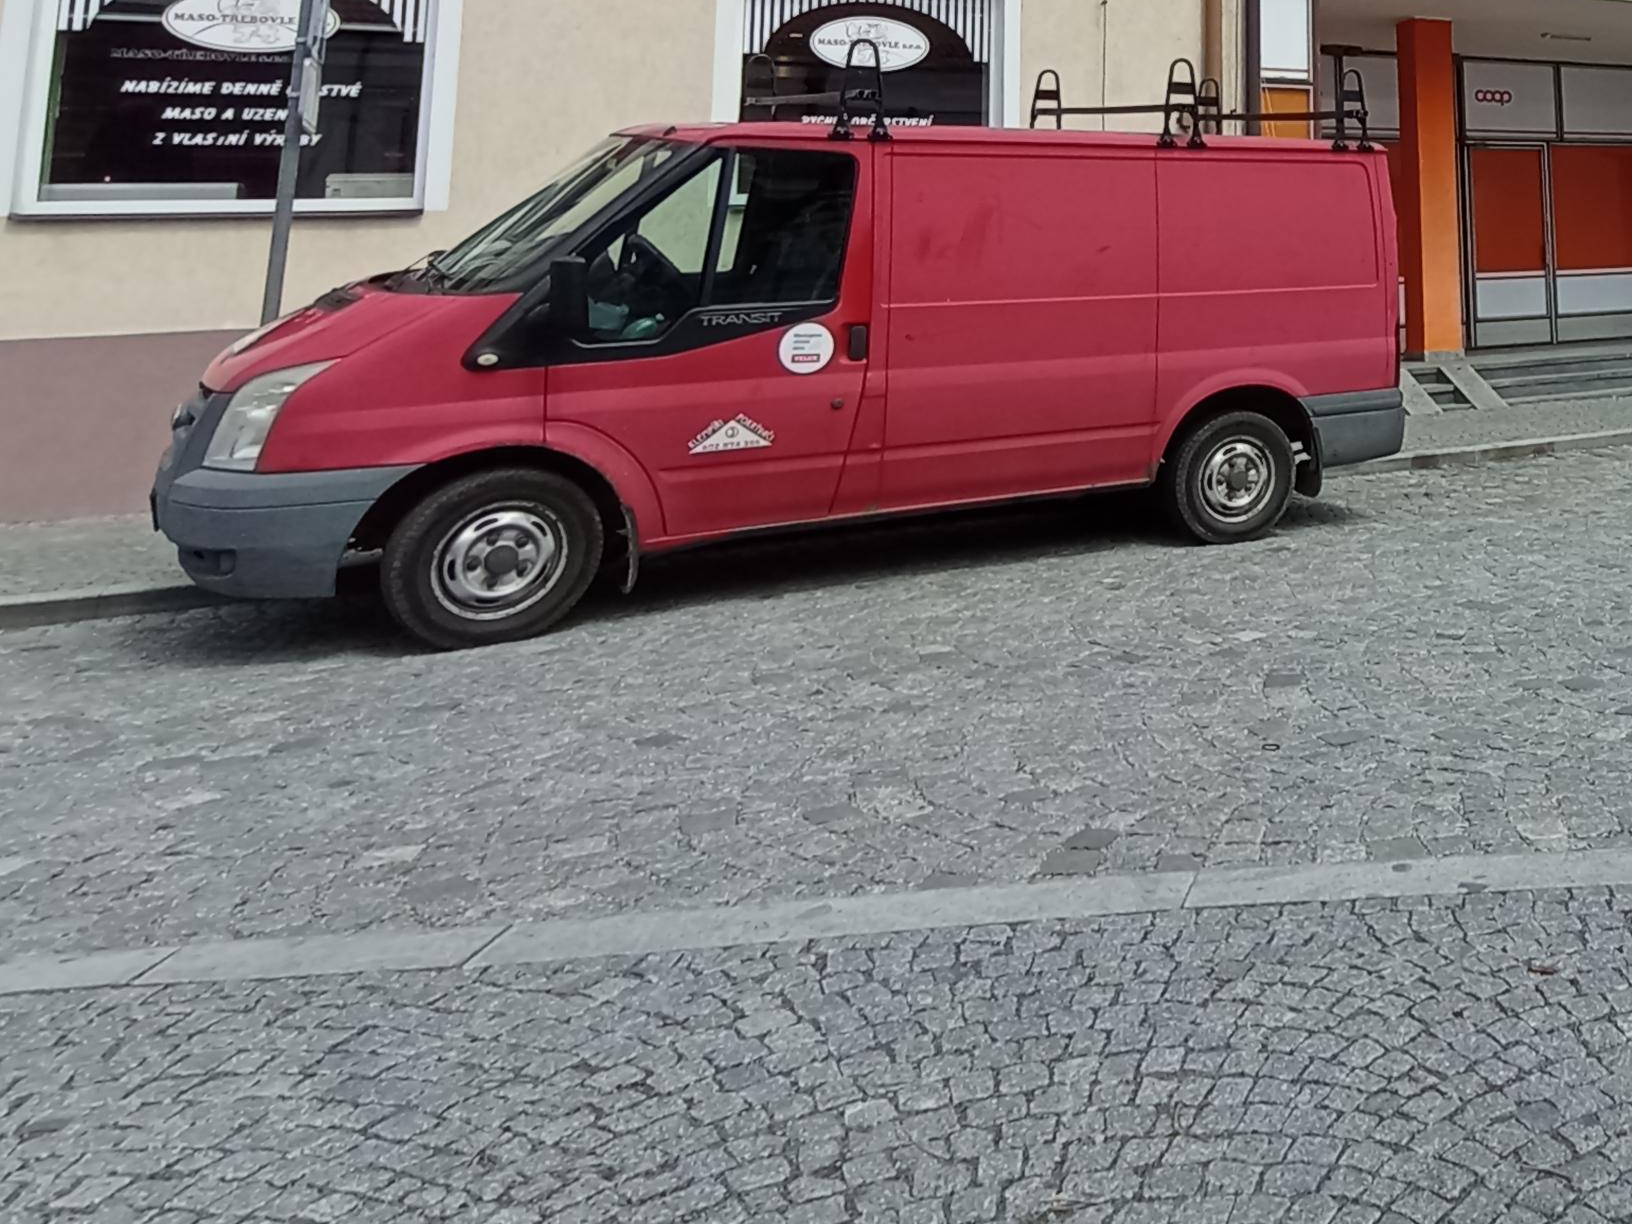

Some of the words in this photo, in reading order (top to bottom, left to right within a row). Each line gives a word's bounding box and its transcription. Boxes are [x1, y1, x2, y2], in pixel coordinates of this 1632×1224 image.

[120, 77, 215, 95] NABÍZÍME
[220, 80, 283, 97] DENNĚ
[1474, 89, 1512, 106] coop
[161, 107, 217, 121] MASO
[220, 108, 235, 121] A
[152, 132, 166, 145] Z
[700, 312, 783, 327] TRANSIT
